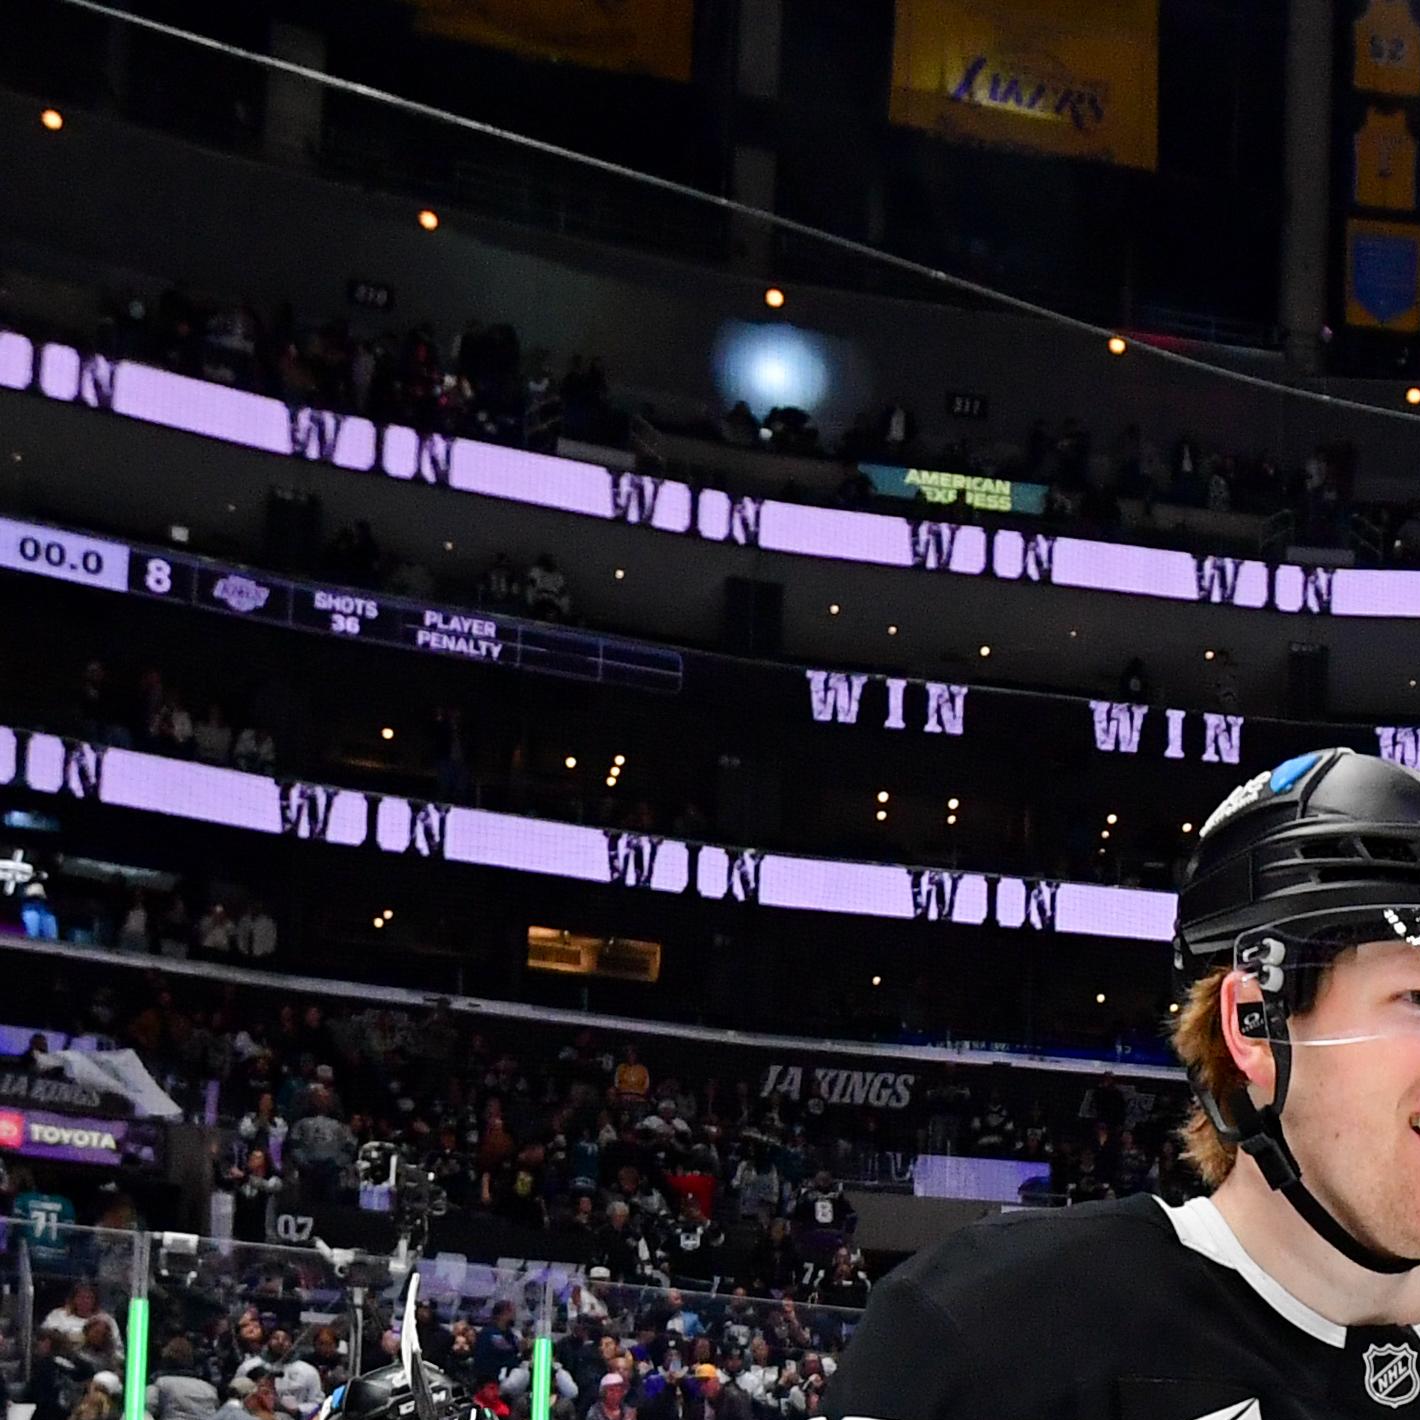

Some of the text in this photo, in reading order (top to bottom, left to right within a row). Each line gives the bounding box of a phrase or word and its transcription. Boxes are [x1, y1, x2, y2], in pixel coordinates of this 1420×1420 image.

[904, 468, 1012, 495] AMERICAN
[921, 486, 1012, 513] EXPESS
[19, 537, 103, 575] 00.0
[144, 557, 173, 594] 8
[313, 591, 379, 620] SHOTS
[423, 609, 498, 638] PLAYER
[416, 630, 504, 660] PENALTY
[805, 669, 969, 736] WIN
[1089, 701, 1245, 764] WIN
[30, 1123, 117, 1150] TOYOTA
[1377, 1360, 1408, 1393] NHL
